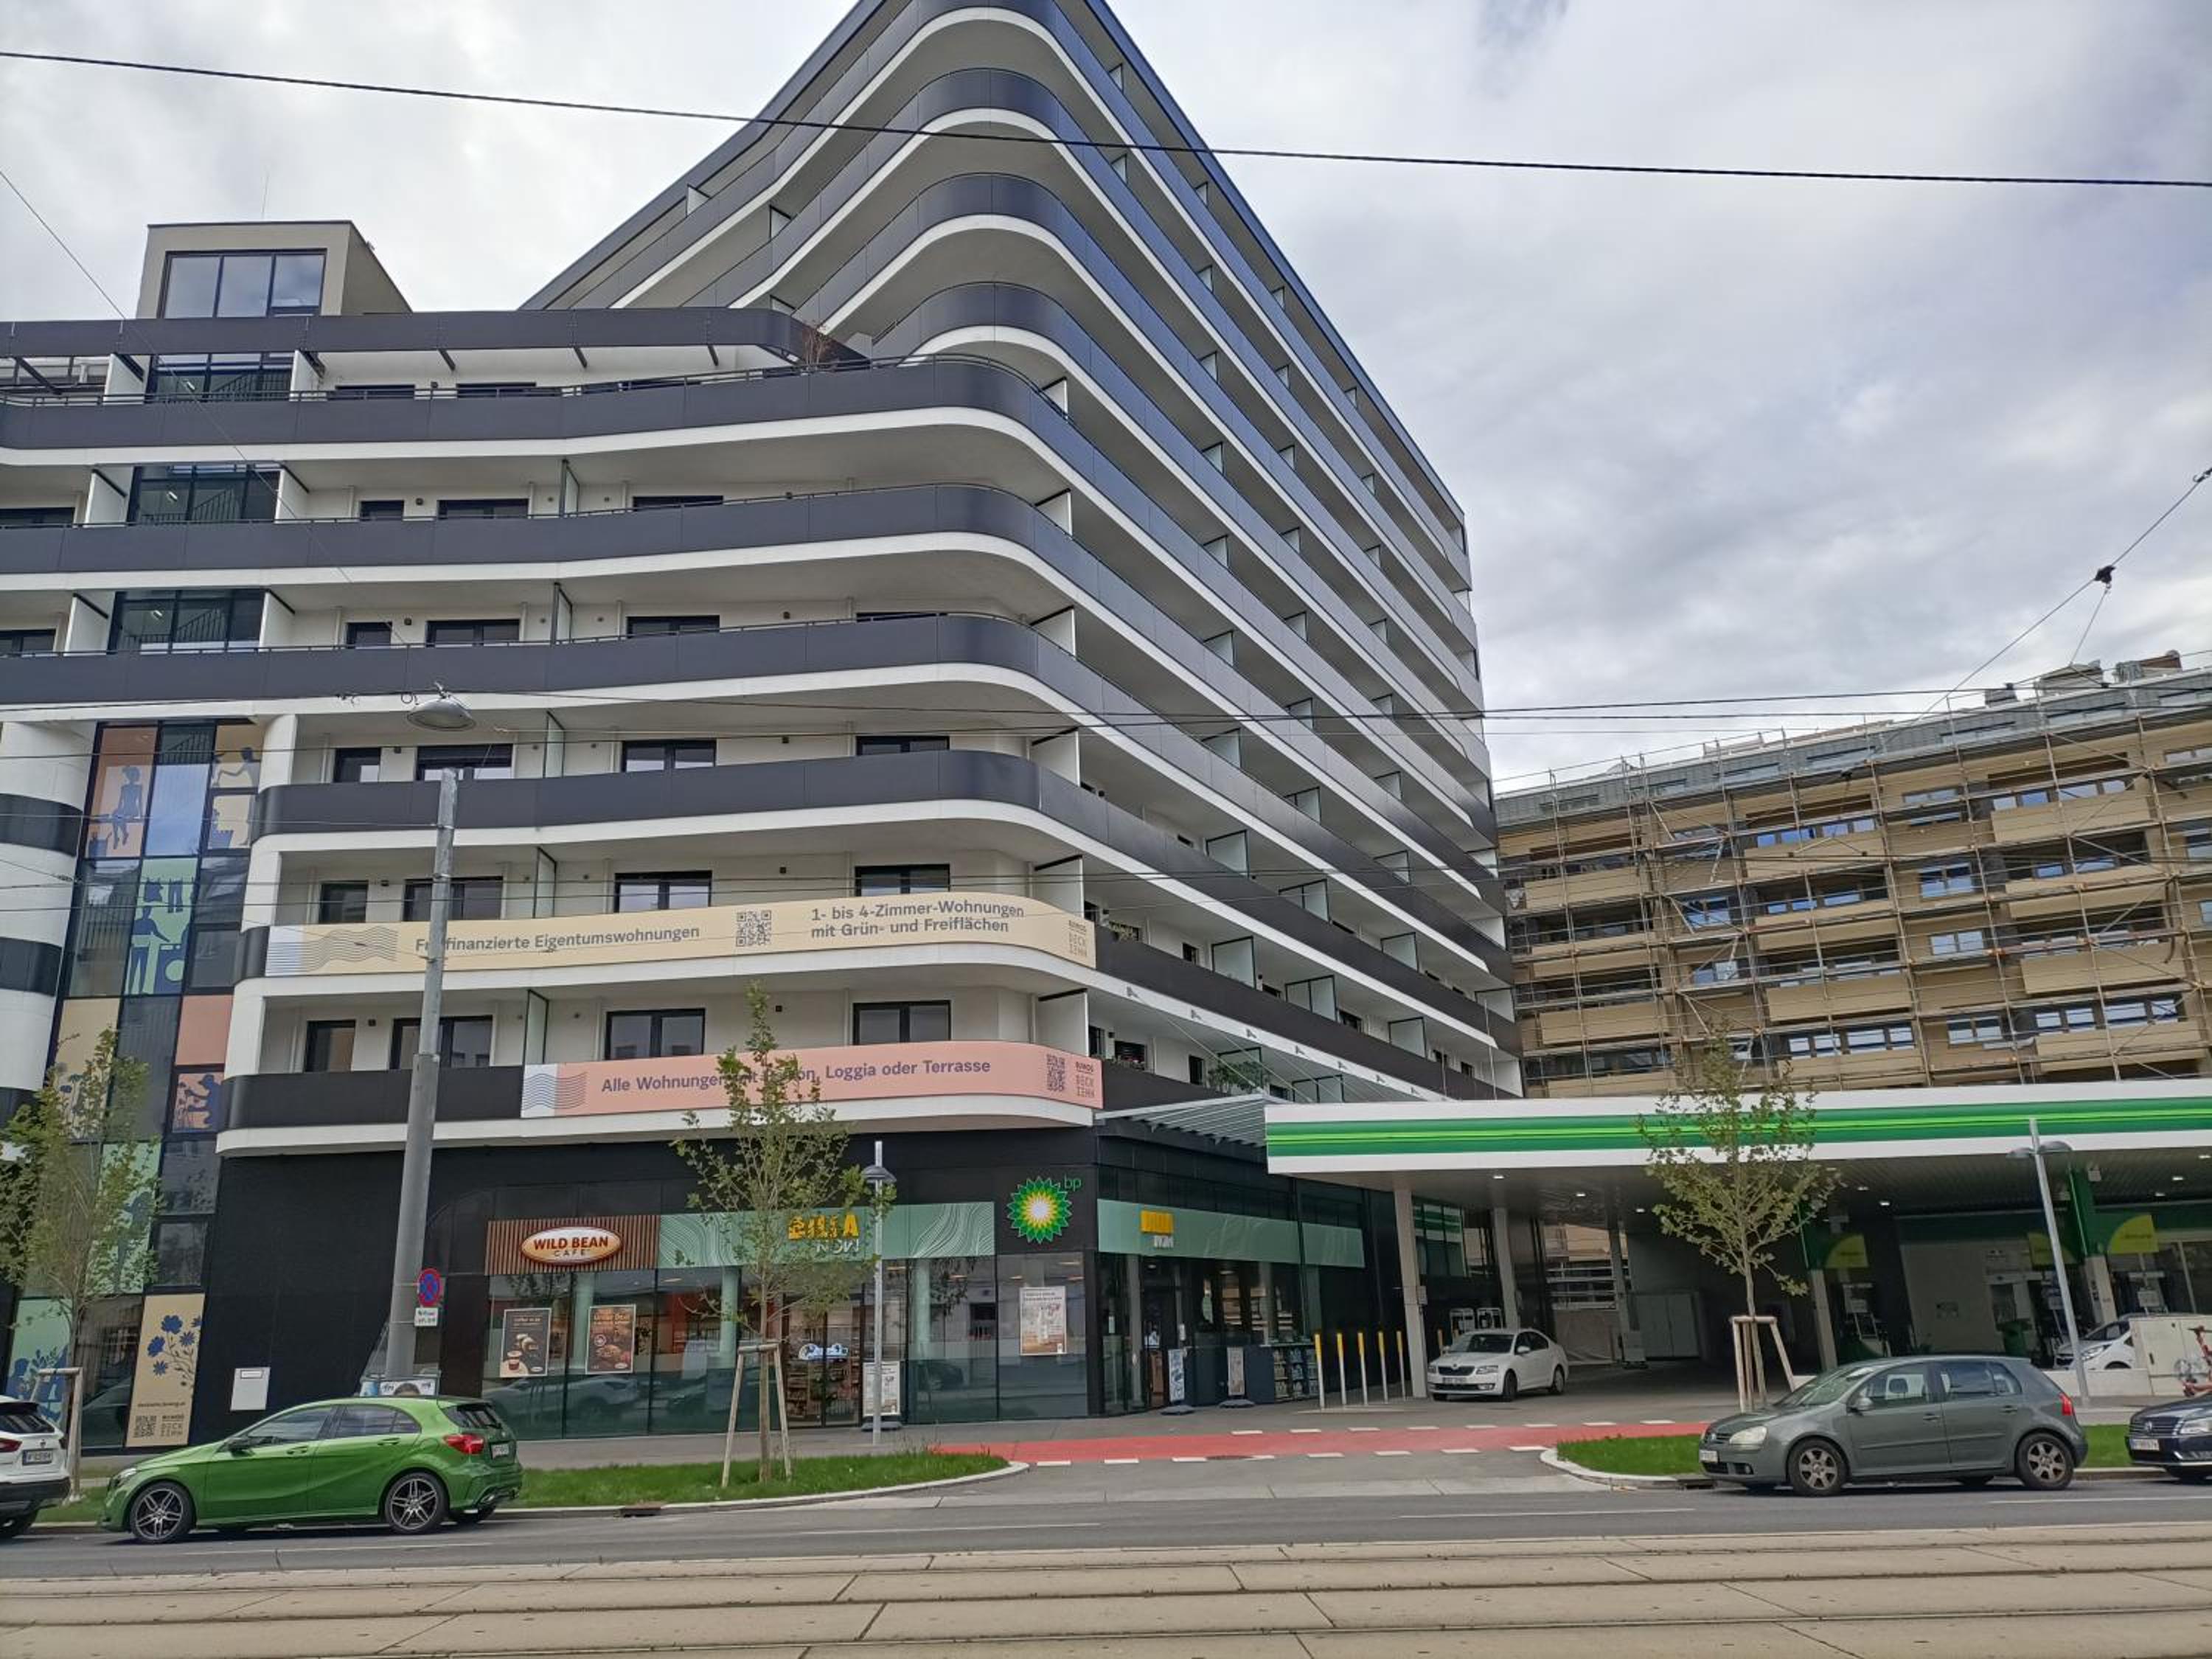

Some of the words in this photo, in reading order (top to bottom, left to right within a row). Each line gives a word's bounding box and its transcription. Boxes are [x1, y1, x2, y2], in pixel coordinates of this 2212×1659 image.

[811, 908, 827, 921] 1-
[832, 906, 854, 919] bis
[859, 899, 1024, 918] 4-Zimmer-Wohnungen
[812, 925, 835, 938] mit
[841, 921, 884, 936] Grün-
[890, 919, 919, 933] und
[925, 917, 1009, 933] Freiflächen
[535, 927, 700, 950] Eigentumswohnungen
[602, 1077, 630, 1092] Alle
[826, 1062, 877, 1081] Loggia
[881, 1061, 918, 1075] oder
[923, 1060, 991, 1074] Terrasse
[1064, 1173, 1082, 1192] bp
[534, 1238, 568, 1251] WILD
[571, 1237, 608, 1248] BEAN
